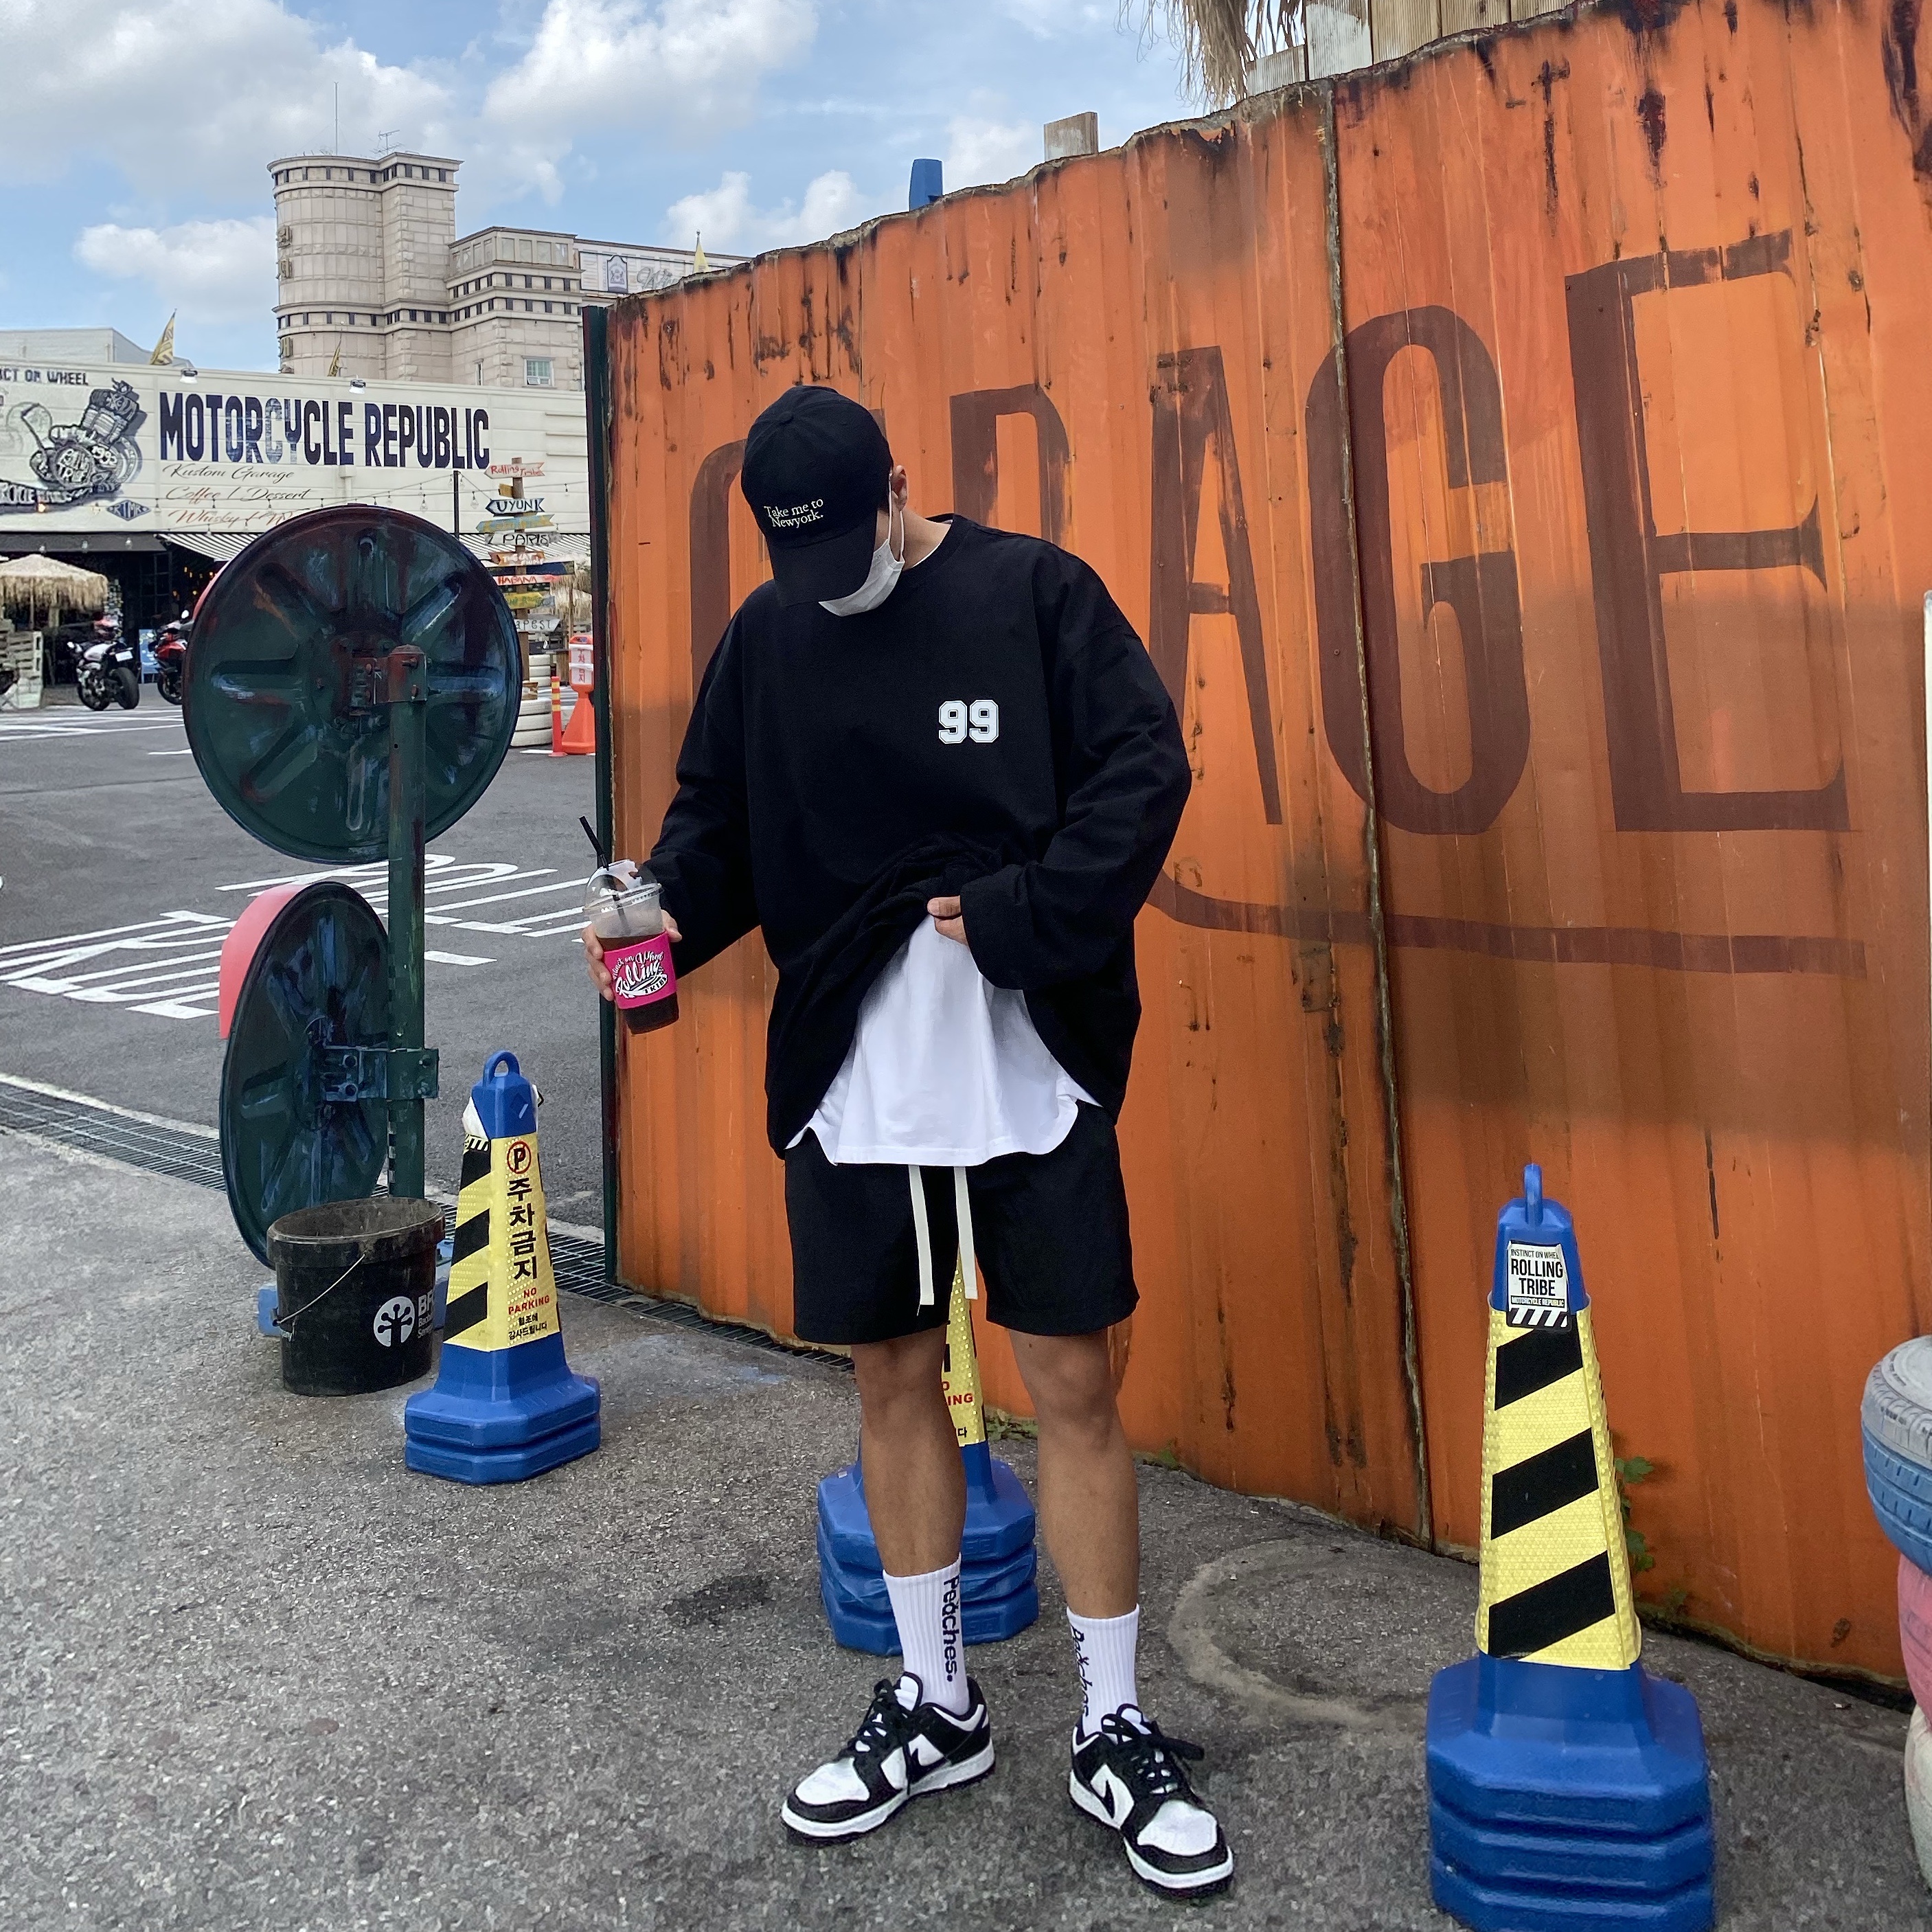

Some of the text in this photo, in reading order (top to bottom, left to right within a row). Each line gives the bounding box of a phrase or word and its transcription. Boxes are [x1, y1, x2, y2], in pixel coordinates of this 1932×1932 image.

[47, 370, 89, 385] WHEEL
[159, 391, 354, 465] MOTORCYCLE
[365, 402, 490, 470] REPUBLIC
[162, 463, 295, 484] Kustom Garage
[490, 464, 520, 475] Rolling
[166, 486, 221, 505] Coffee
[240, 486, 312, 502] Dessert
[763, 499, 823, 517] Take me to
[168, 509, 240, 529] Whisky
[770, 509, 823, 529] Newyork.
[502, 533, 550, 547] PARIS
[689, 232, 1849, 836] AGE
[497, 576, 538, 585] HABANA
[938, 699, 999, 744] 99
[615, 959, 661, 999] Rolling
[507, 1177, 538, 1280] 주차금지
[1511, 1249, 1534, 1258] INSTINCT
[1535, 1251, 1543, 1259] ON
[1511, 1258, 1563, 1278] ROLLING
[523, 1287, 537, 1299] NO
[1518, 1277, 1556, 1297] TRIBE
[508, 1295, 549, 1315] PARKING
[508, 1321, 547, 1341] 감사드립니다
[942, 1574, 960, 1682] Peaches.
